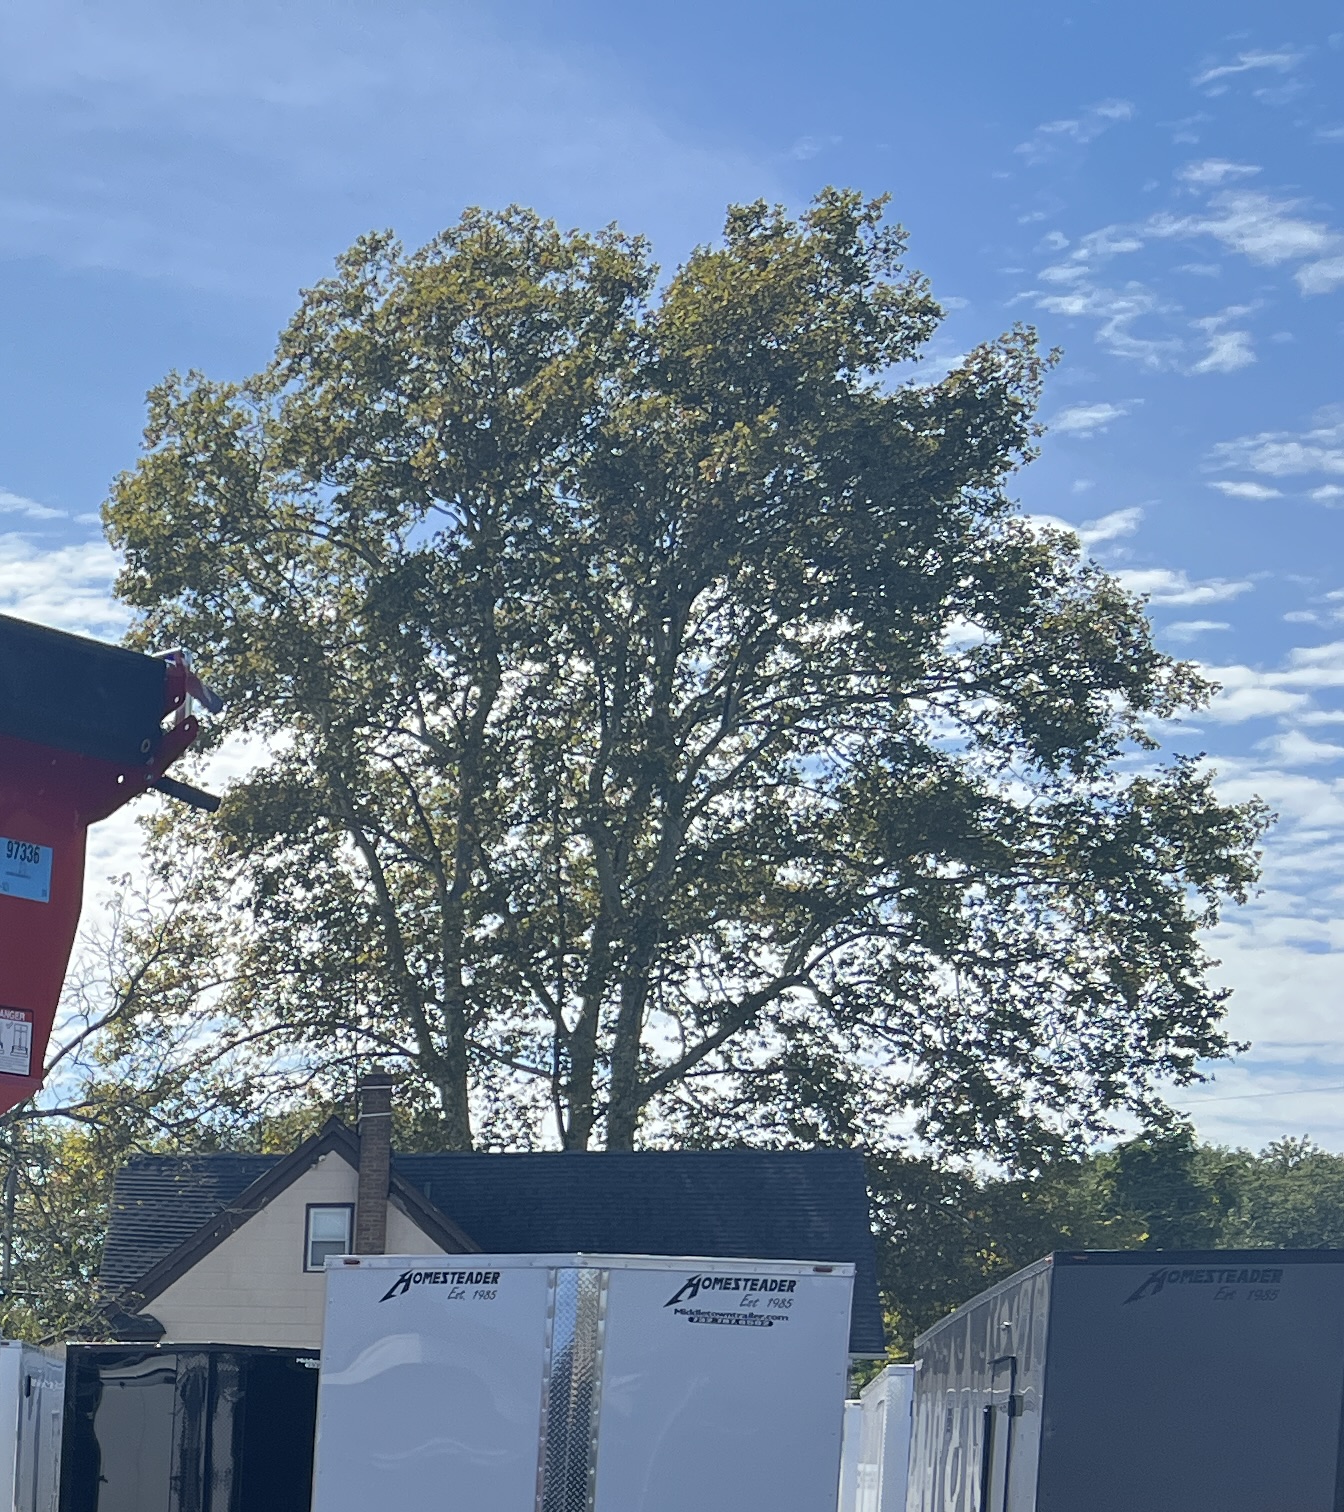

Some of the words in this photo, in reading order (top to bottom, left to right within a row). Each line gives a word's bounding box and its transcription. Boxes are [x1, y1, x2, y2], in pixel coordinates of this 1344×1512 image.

[6, 840, 41, 864] 97336
[378, 1269, 501, 1303] HOMESTEADER
[472, 1289, 498, 1300] 1985
[663, 1273, 797, 1308] HOMESTEADER
[1122, 1267, 1284, 1306] HOMESTEADER
[1247, 1288, 1281, 1301] 1985
[767, 1298, 794, 1309] 1985
